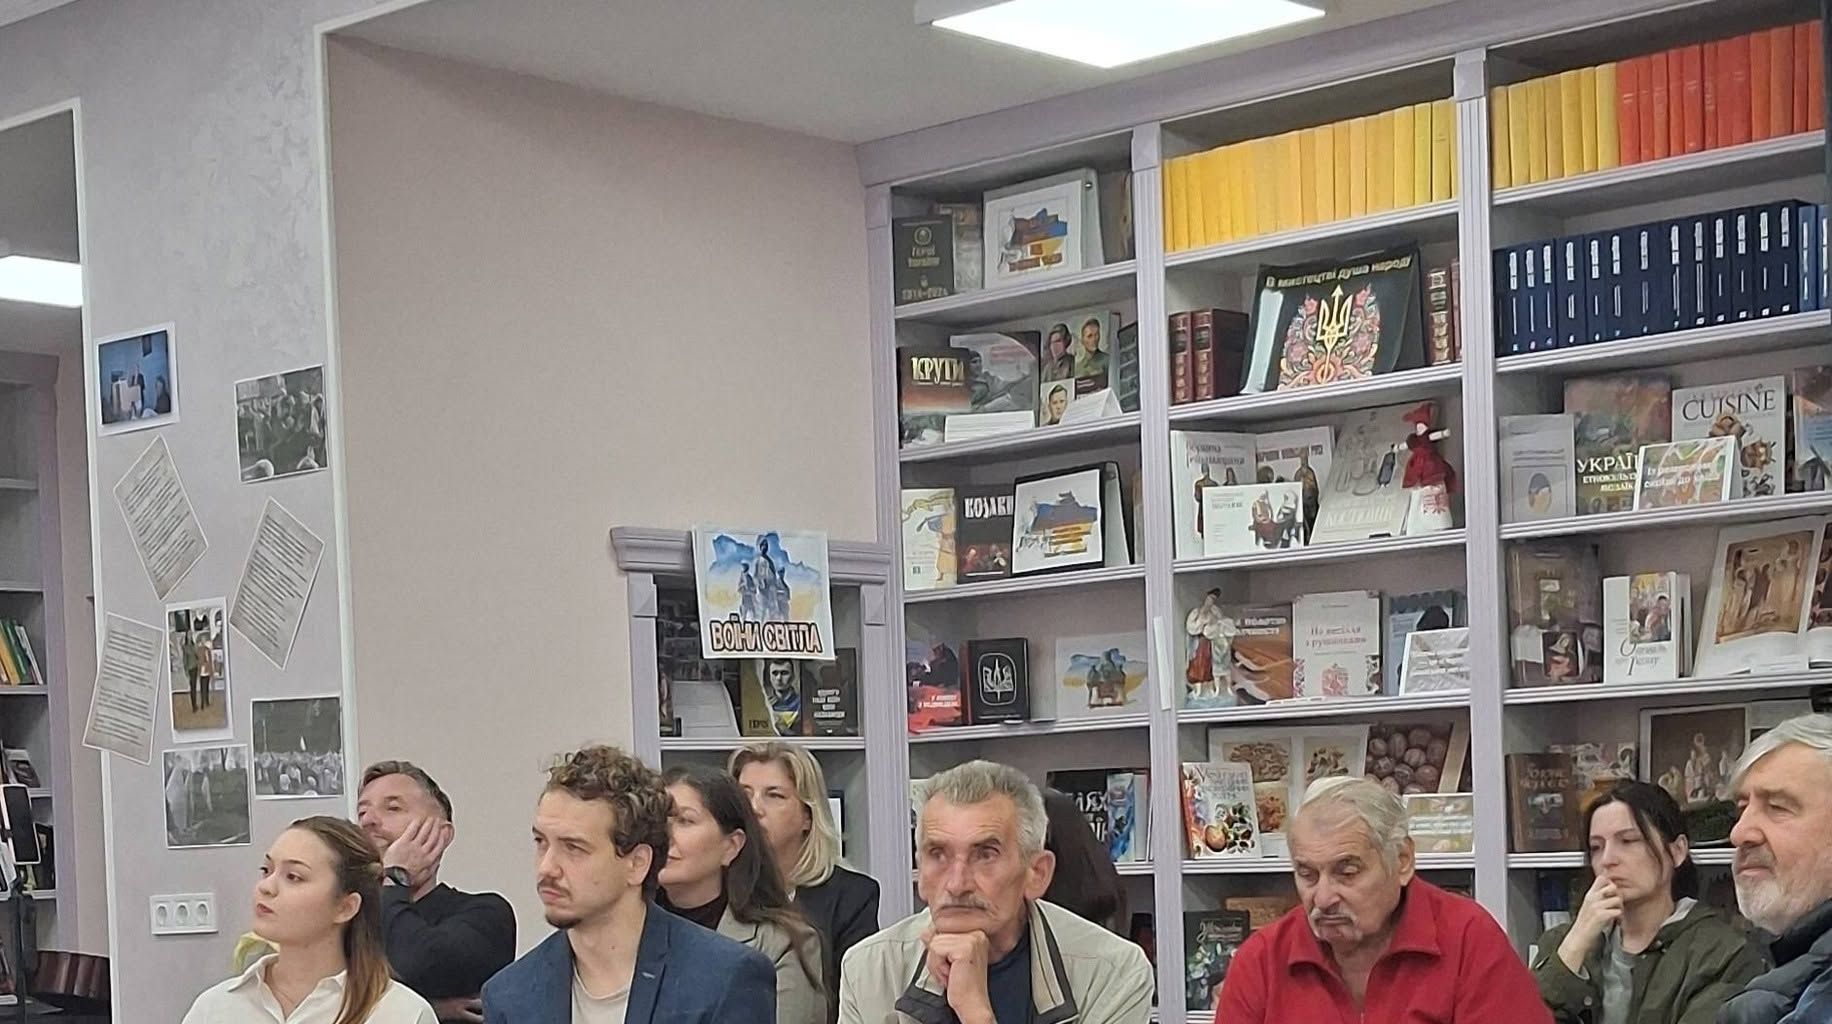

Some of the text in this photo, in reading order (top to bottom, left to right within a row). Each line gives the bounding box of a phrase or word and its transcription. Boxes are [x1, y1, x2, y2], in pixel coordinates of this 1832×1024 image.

[911, 357, 964, 384] КРУТИ
[1682, 389, 1776, 421] CUISINE
[710, 613, 823, 653] ВОЇНИ СВІТЛА
